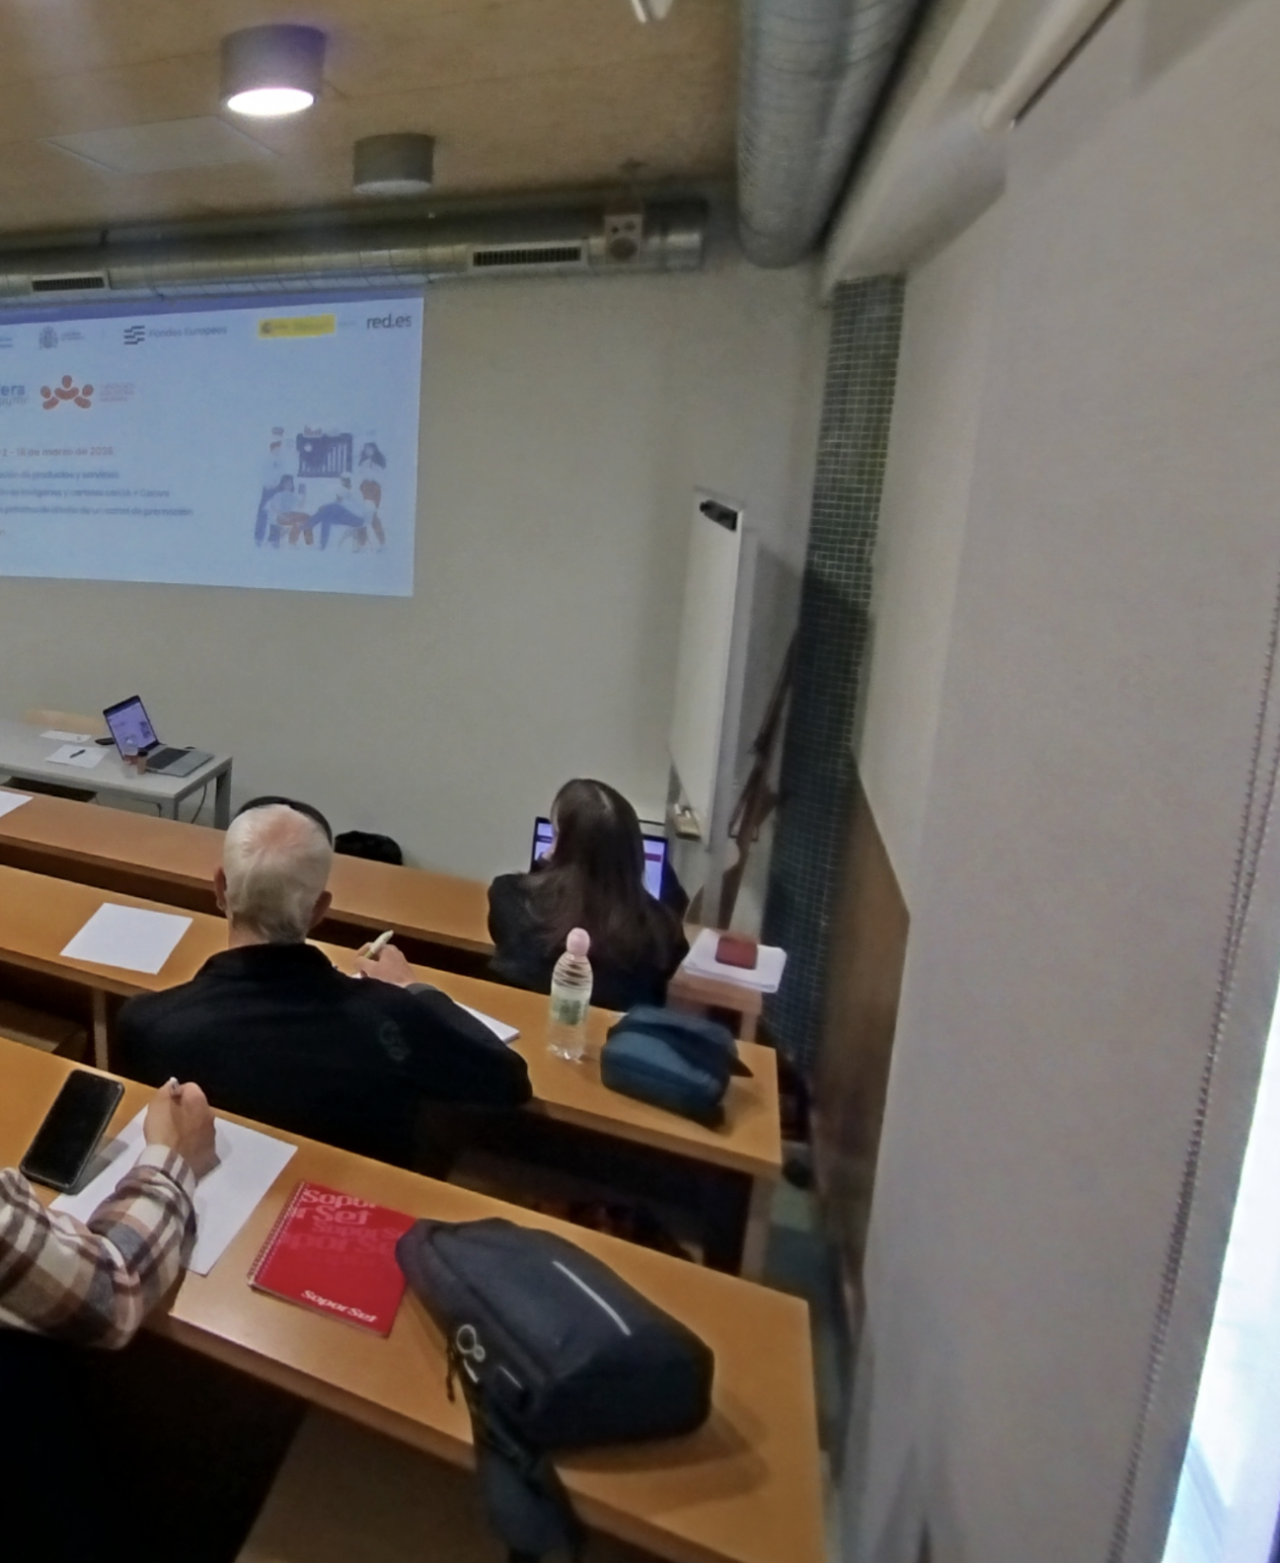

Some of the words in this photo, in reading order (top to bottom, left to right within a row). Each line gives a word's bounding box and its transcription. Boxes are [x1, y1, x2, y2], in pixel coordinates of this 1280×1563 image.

[366, 313, 412, 329] red.es
[28, 447, 40, 457] de
[42, 447, 73, 457] marzo
[75, 446, 88, 456] de
